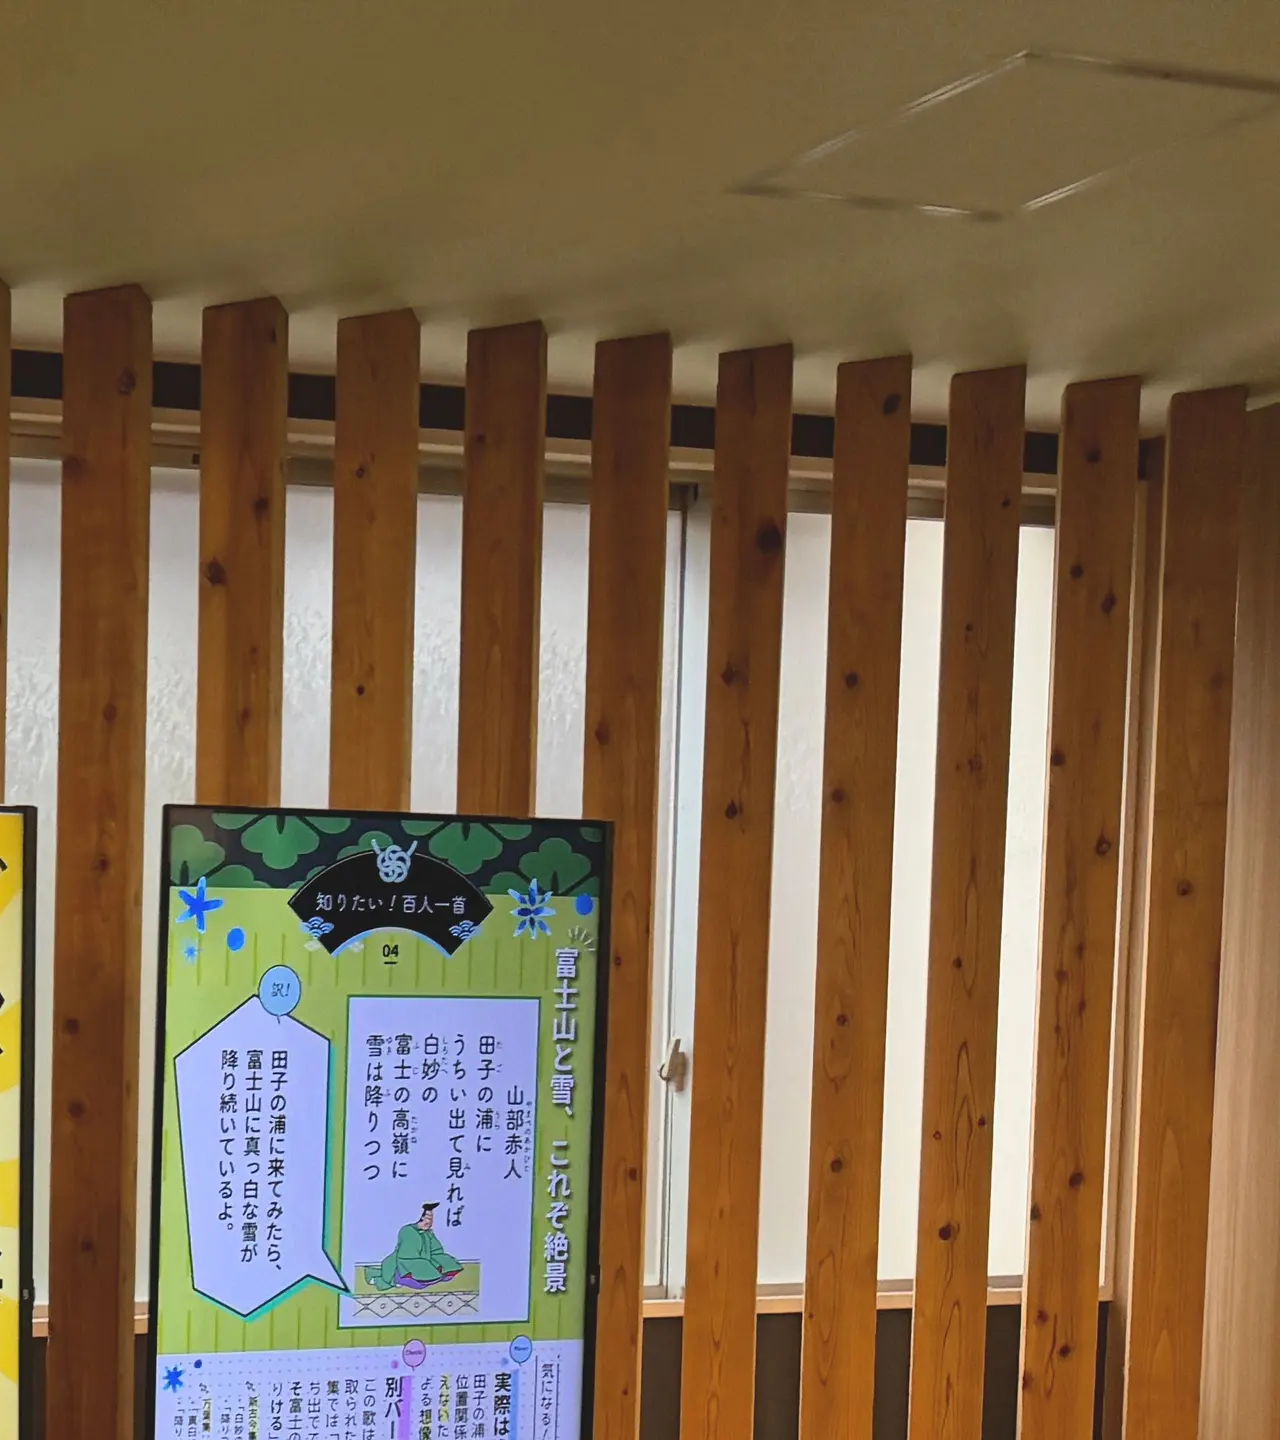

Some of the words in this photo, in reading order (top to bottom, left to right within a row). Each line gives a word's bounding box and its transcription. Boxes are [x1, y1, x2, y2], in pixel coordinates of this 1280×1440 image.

[315, 892, 467, 915] 知りたい！百人一首
[382, 944, 399, 959] 04
[218, 1050, 238, 1232] 降り続いているよ。
[363, 1034, 385, 1181] 雪は降りつつ
[392, 1033, 413, 1179] 富士の高嶺に
[421, 1033, 440, 1103] 白妙の
[445, 1034, 467, 1227] うちい出て見れば
[476, 1036, 495, 1153] 田子の浦に
[503, 1086, 526, 1180] 山部赤人
[240, 1050, 263, 1262] 富士山に真っ白な雪が
[265, 1051, 288, 1271] 田子の浦に来てみたら、
